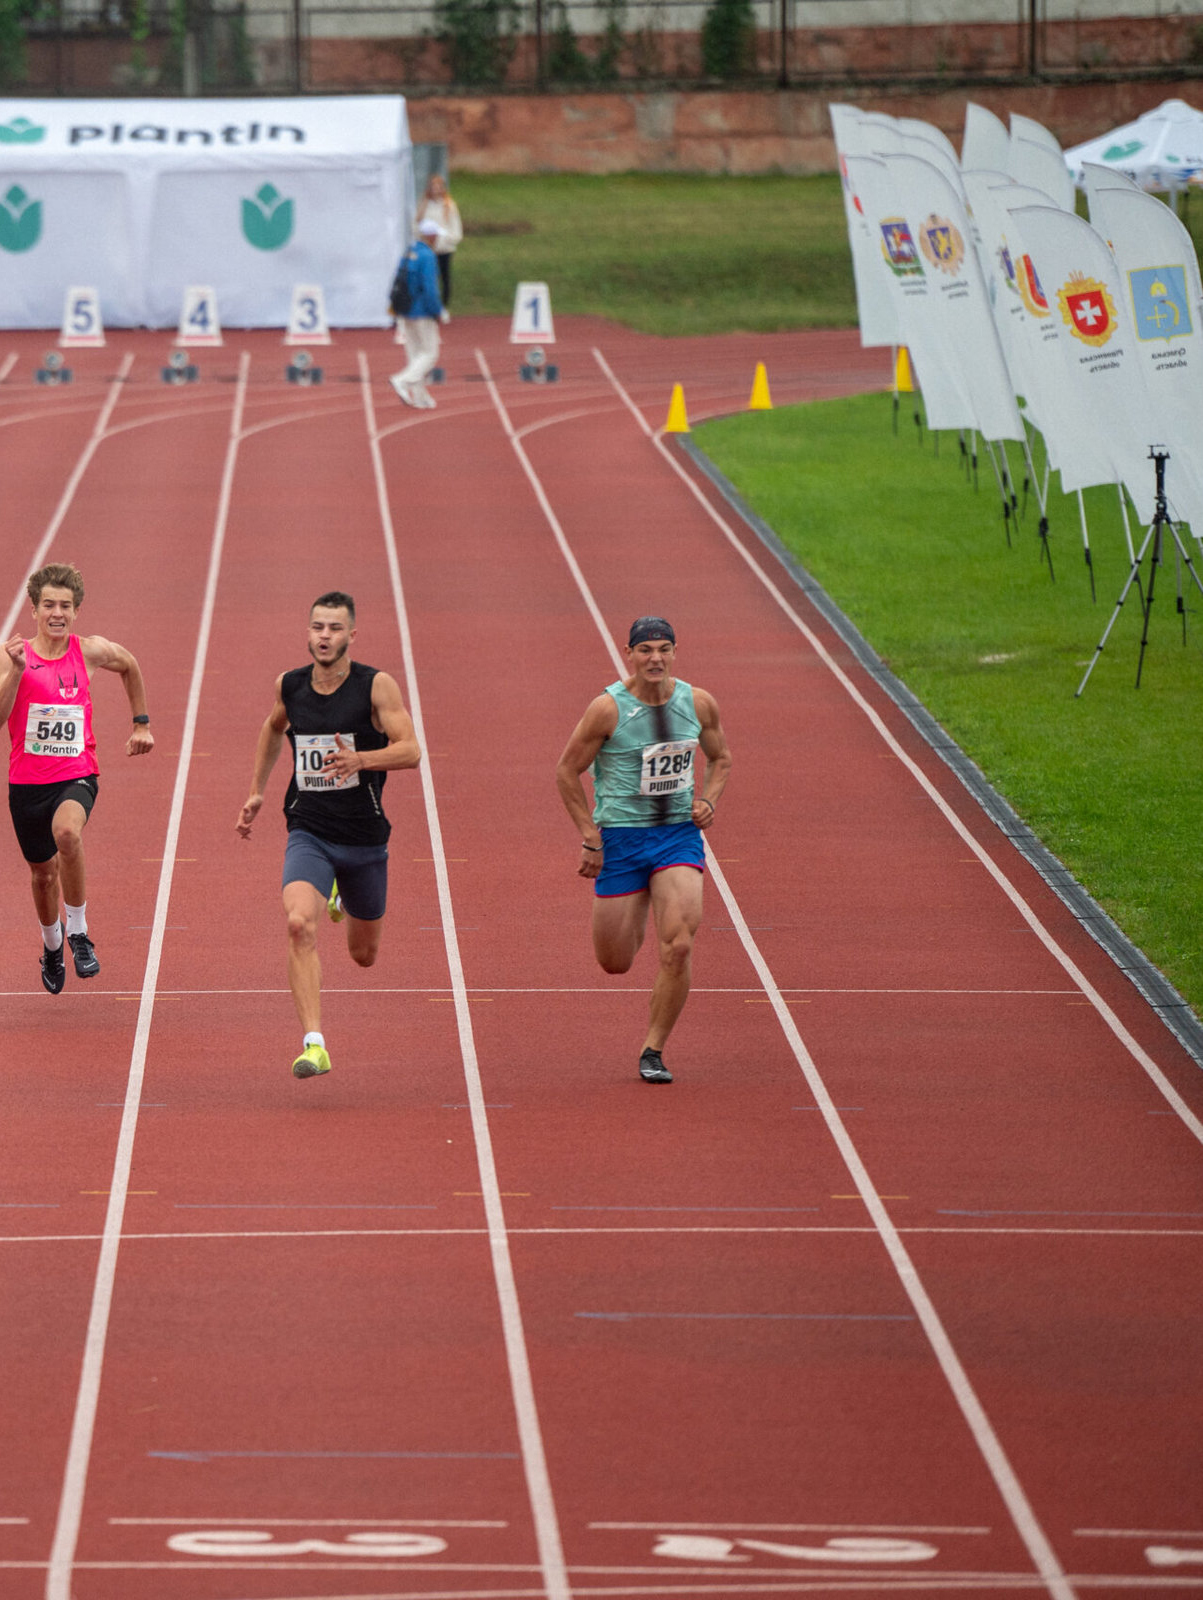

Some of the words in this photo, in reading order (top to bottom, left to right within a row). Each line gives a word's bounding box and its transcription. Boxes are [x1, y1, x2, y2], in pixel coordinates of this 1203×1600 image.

[72, 299, 94, 333] 5
[189, 298, 211, 331] 4
[298, 298, 319, 330] 3
[525, 297, 541, 328] 1
[36, 721, 76, 741] 549
[43, 744, 78, 754] Plantin
[647, 750, 692, 777] 1289
[304, 776, 335, 787] PUMA
[649, 779, 679, 792] PUMA
[166, 1530, 448, 1557] 3
[652, 1534, 940, 1563] 2
